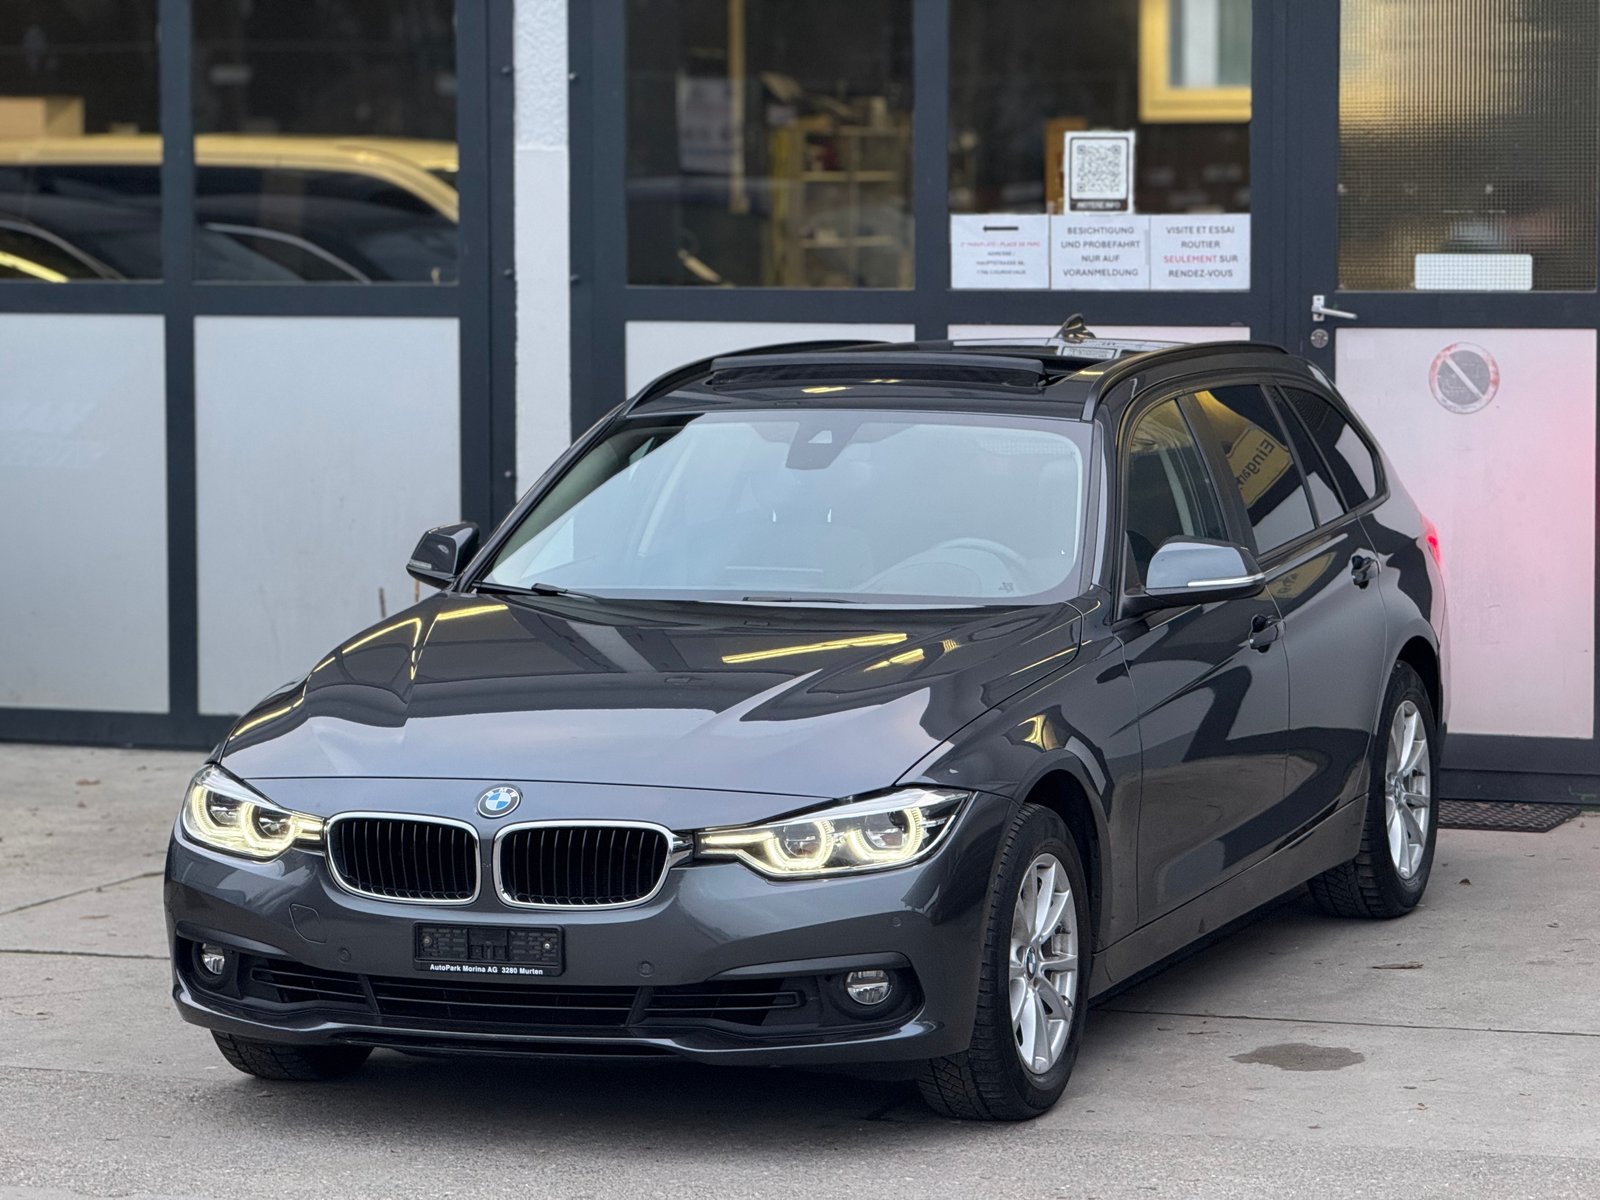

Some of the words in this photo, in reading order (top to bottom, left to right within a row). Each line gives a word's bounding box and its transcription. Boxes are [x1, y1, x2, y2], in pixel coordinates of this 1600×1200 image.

[1066, 226, 1135, 235] BESICHTIGUNG
[1165, 226, 1194, 235] VISITE
[1196, 226, 1207, 235] ET
[1208, 226, 1236, 235] ESSAI
[1060, 240, 1081, 249] UND
[1082, 240, 1141, 249] PROBEFAHRT
[1180, 240, 1221, 249] ROUTIER
[1081, 254, 1101, 263] NUR
[1102, 254, 1120, 263] AUF
[1163, 254, 1217, 264] SEULEMENT
[1219, 254, 1239, 263] SUR
[1063, 268, 1139, 277] VORANMELDUNG
[1168, 269, 1233, 278] RENDEZ-VOUS
[429, 963, 461, 972] AutoPark
[462, 965, 486, 973] Morina
[486, 966, 498, 974] AG
[501, 967, 518, 975] 3280
[519, 967, 544, 976] Murten
